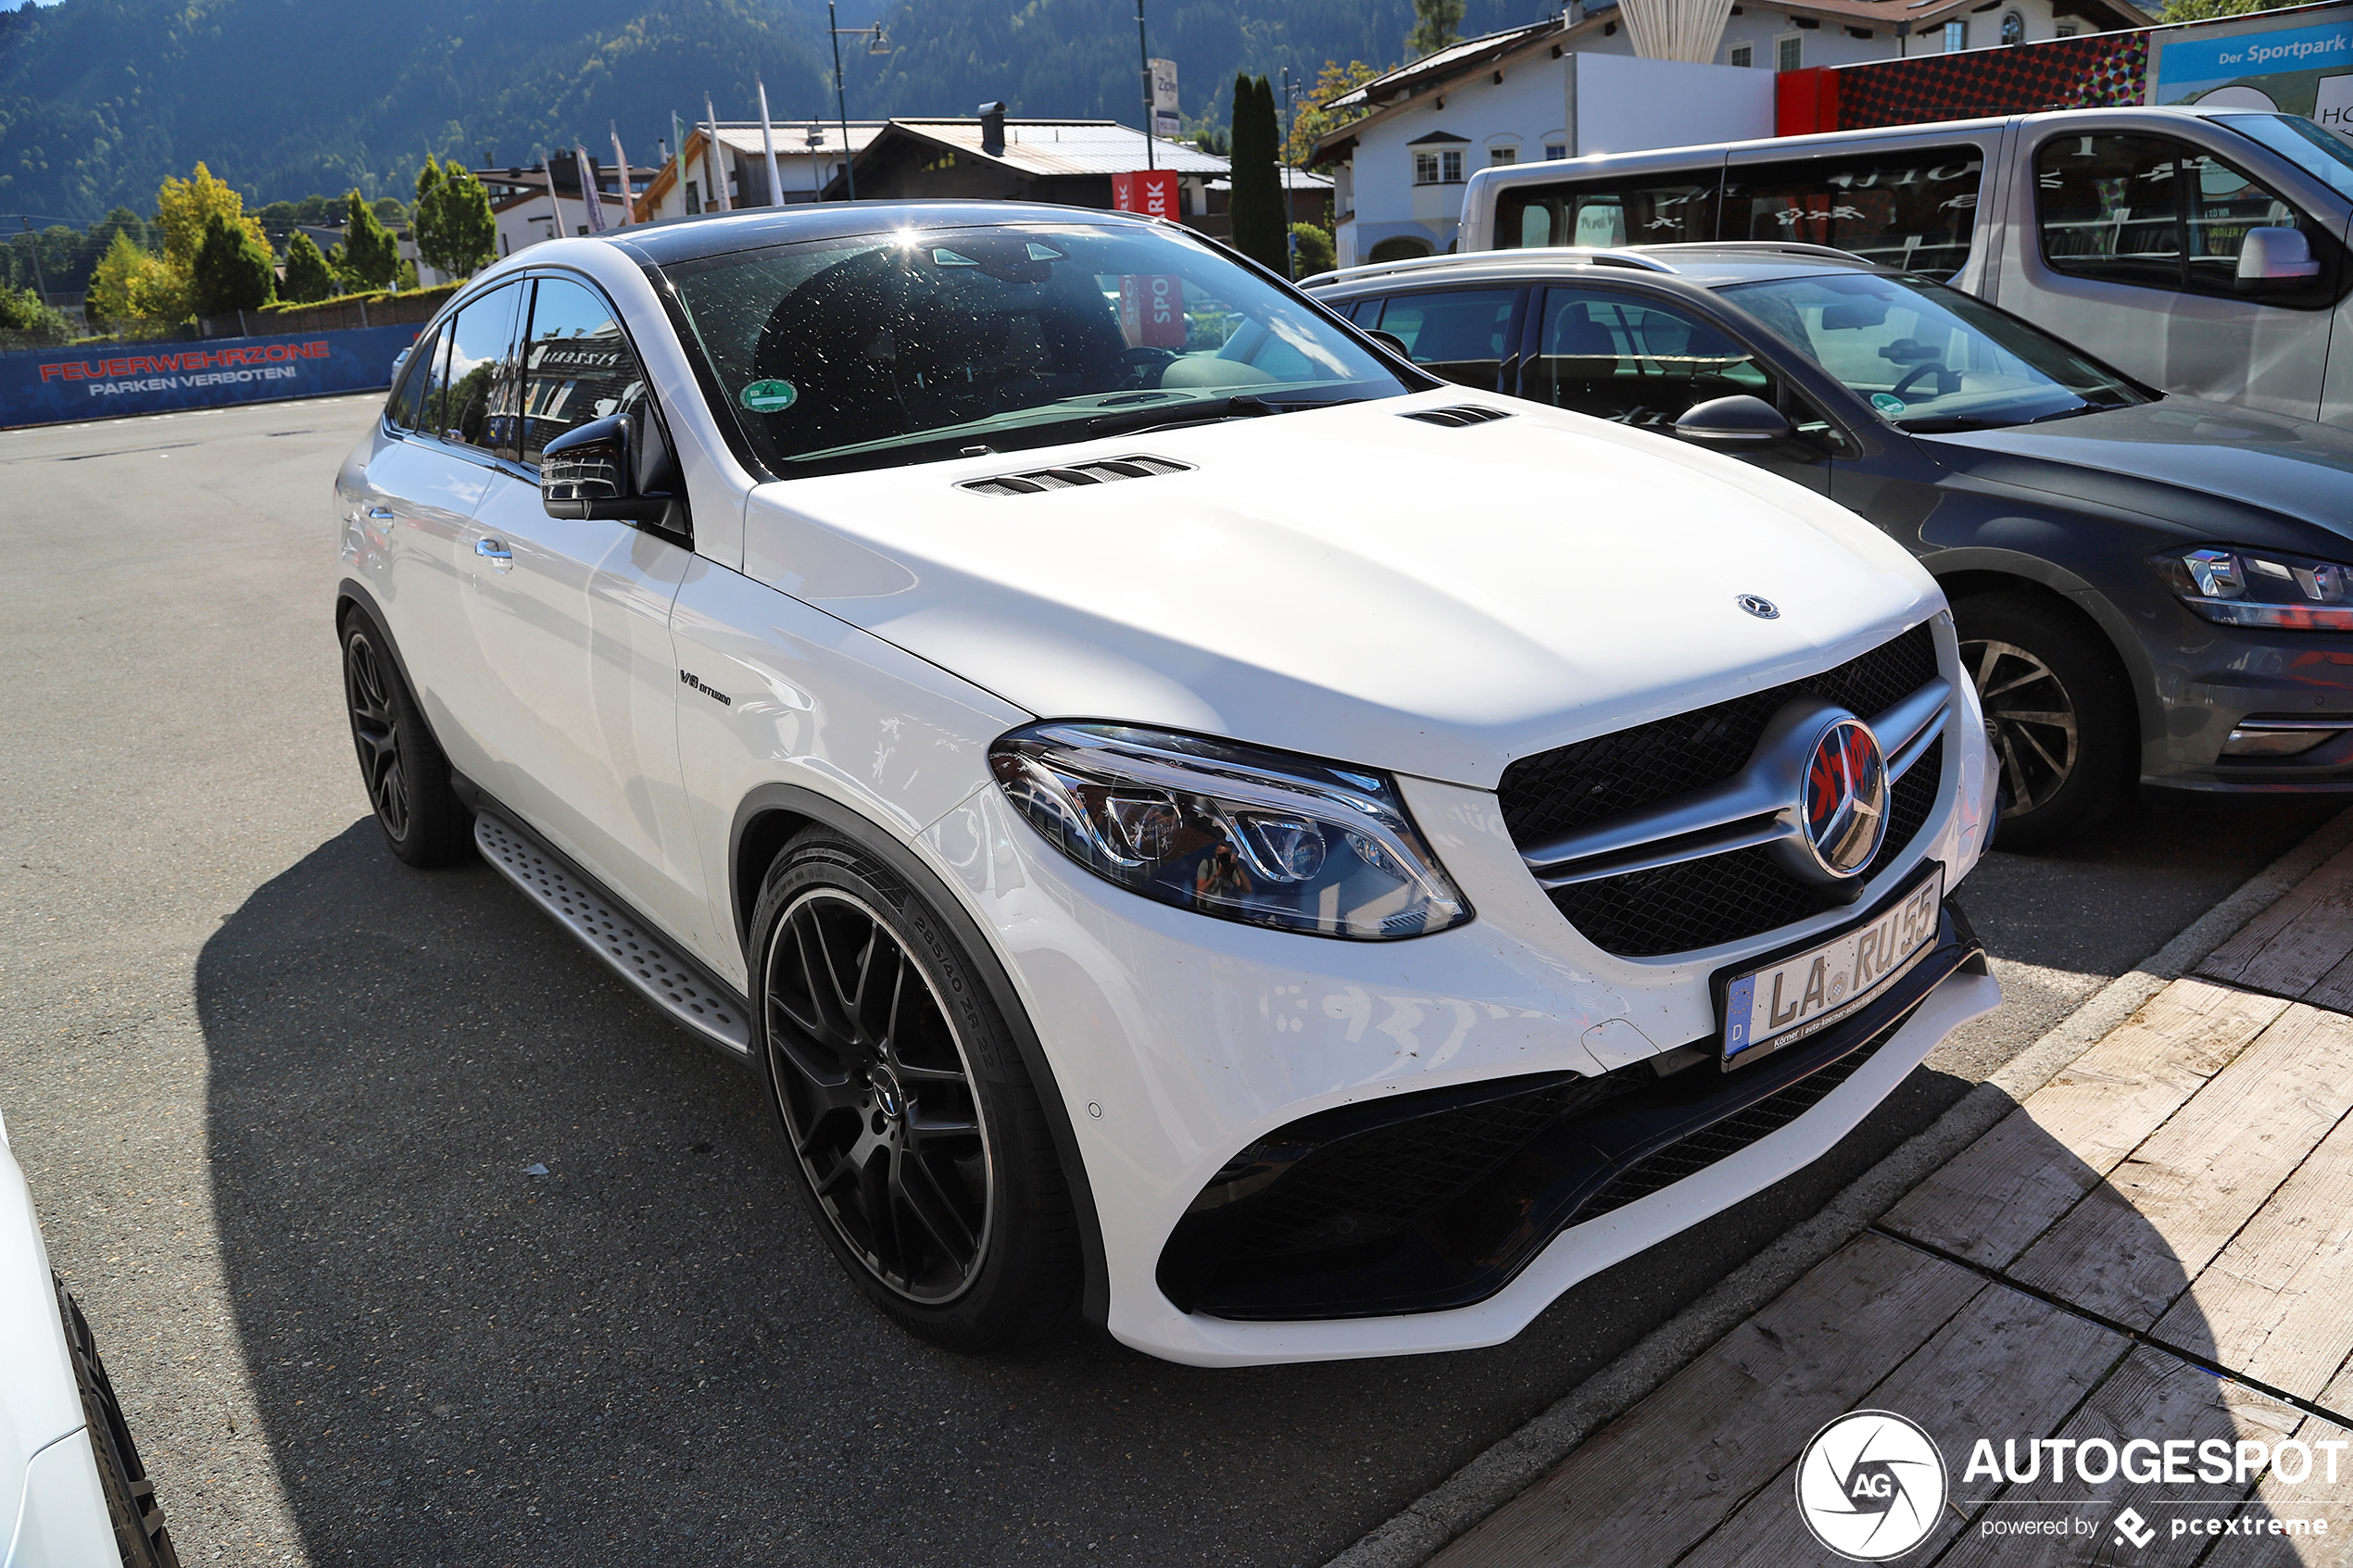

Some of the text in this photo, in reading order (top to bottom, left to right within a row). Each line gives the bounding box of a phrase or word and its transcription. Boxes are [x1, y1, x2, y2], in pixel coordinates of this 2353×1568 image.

[2218, 33, 2347, 65] Der Sportpark
[39, 341, 332, 383] FEUERWEHRZONE
[88, 366, 296, 396] PARKEN VERBOTEN!
[761, 383, 775, 395] 4
[679, 669, 732, 707] V8 BITURBO
[1769, 882, 1934, 1030] LA RU 55
[913, 916, 963, 993] 285/40
[959, 997, 980, 1030] ZR
[976, 1035, 995, 1070] 22
[1732, 1022, 1743, 1042] D
[1773, 1029, 1800, 1048] Körner
